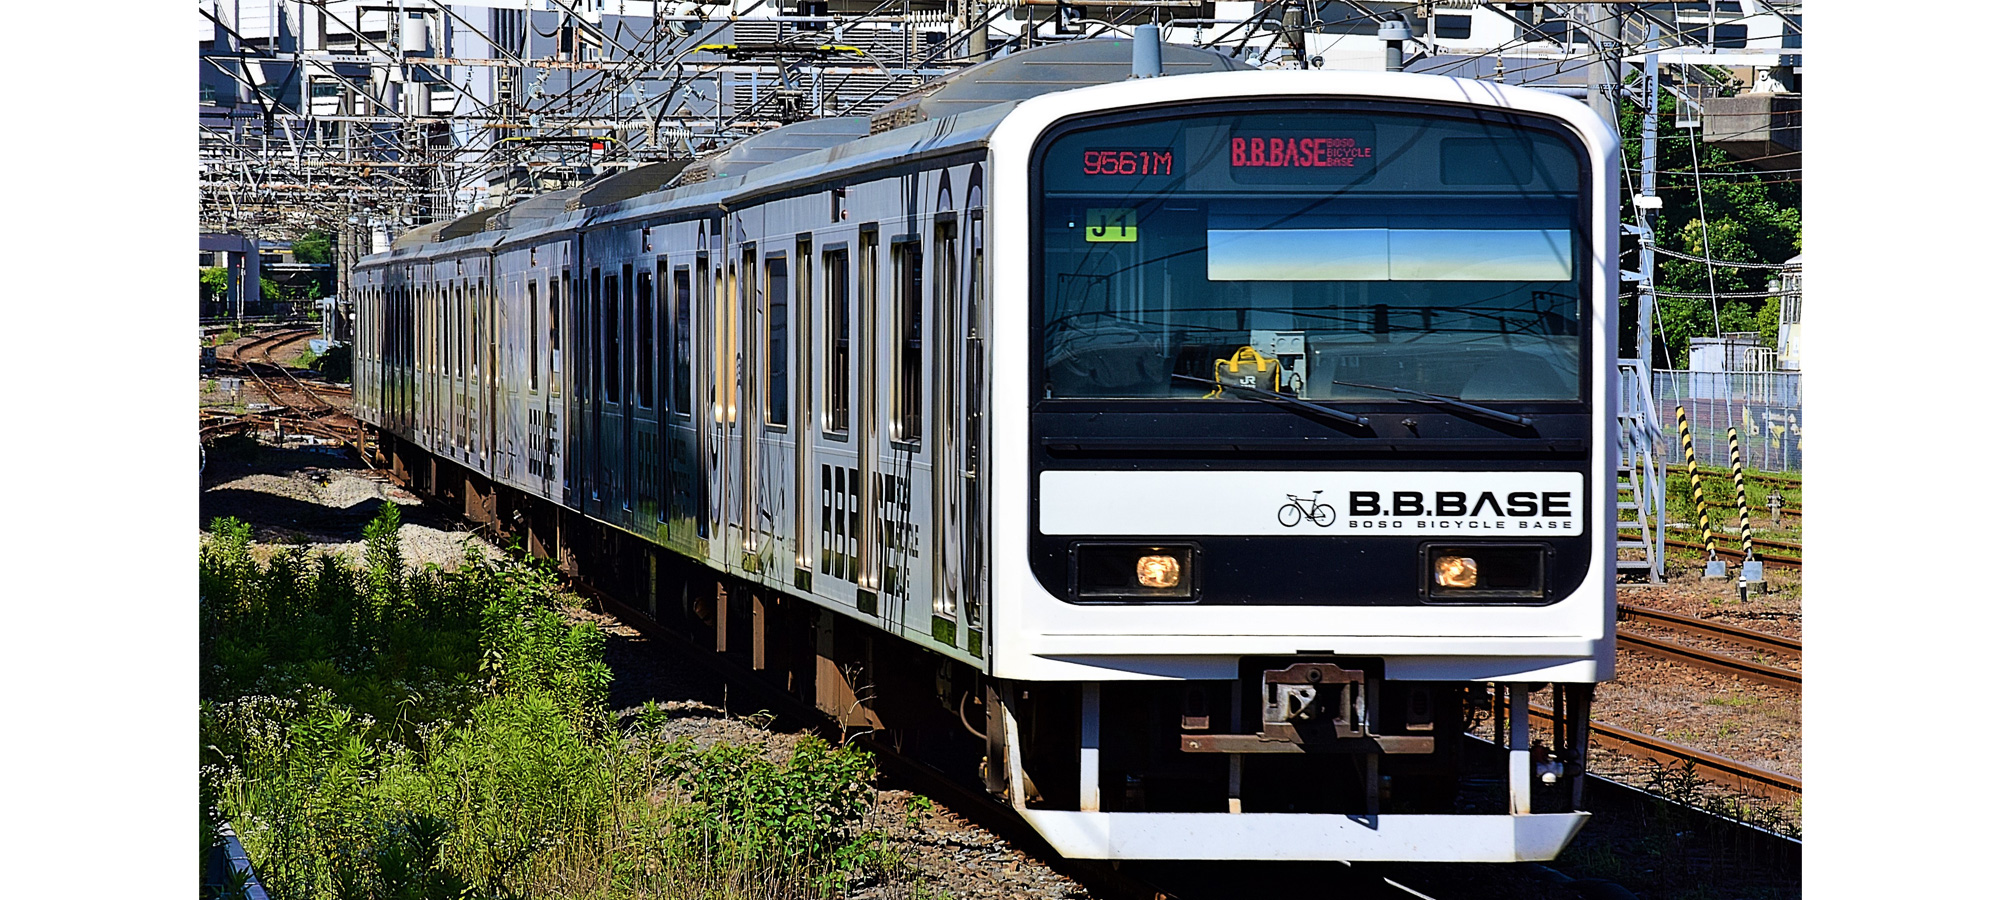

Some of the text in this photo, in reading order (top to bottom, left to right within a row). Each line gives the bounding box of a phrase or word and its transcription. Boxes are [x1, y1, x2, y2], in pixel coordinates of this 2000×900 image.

[1327, 139, 1355, 147] BOSO
[1232, 137, 1326, 167] B.B.BASE
[1327, 148, 1371, 157] BICYCLE
[1084, 151, 1172, 175] 9561M
[1327, 158, 1354, 167] BASE
[1239, 375, 1257, 385] JR
[1349, 491, 1572, 517] B.B.BASE
[1349, 520, 1572, 529] BOSO BICYCLE BASE
